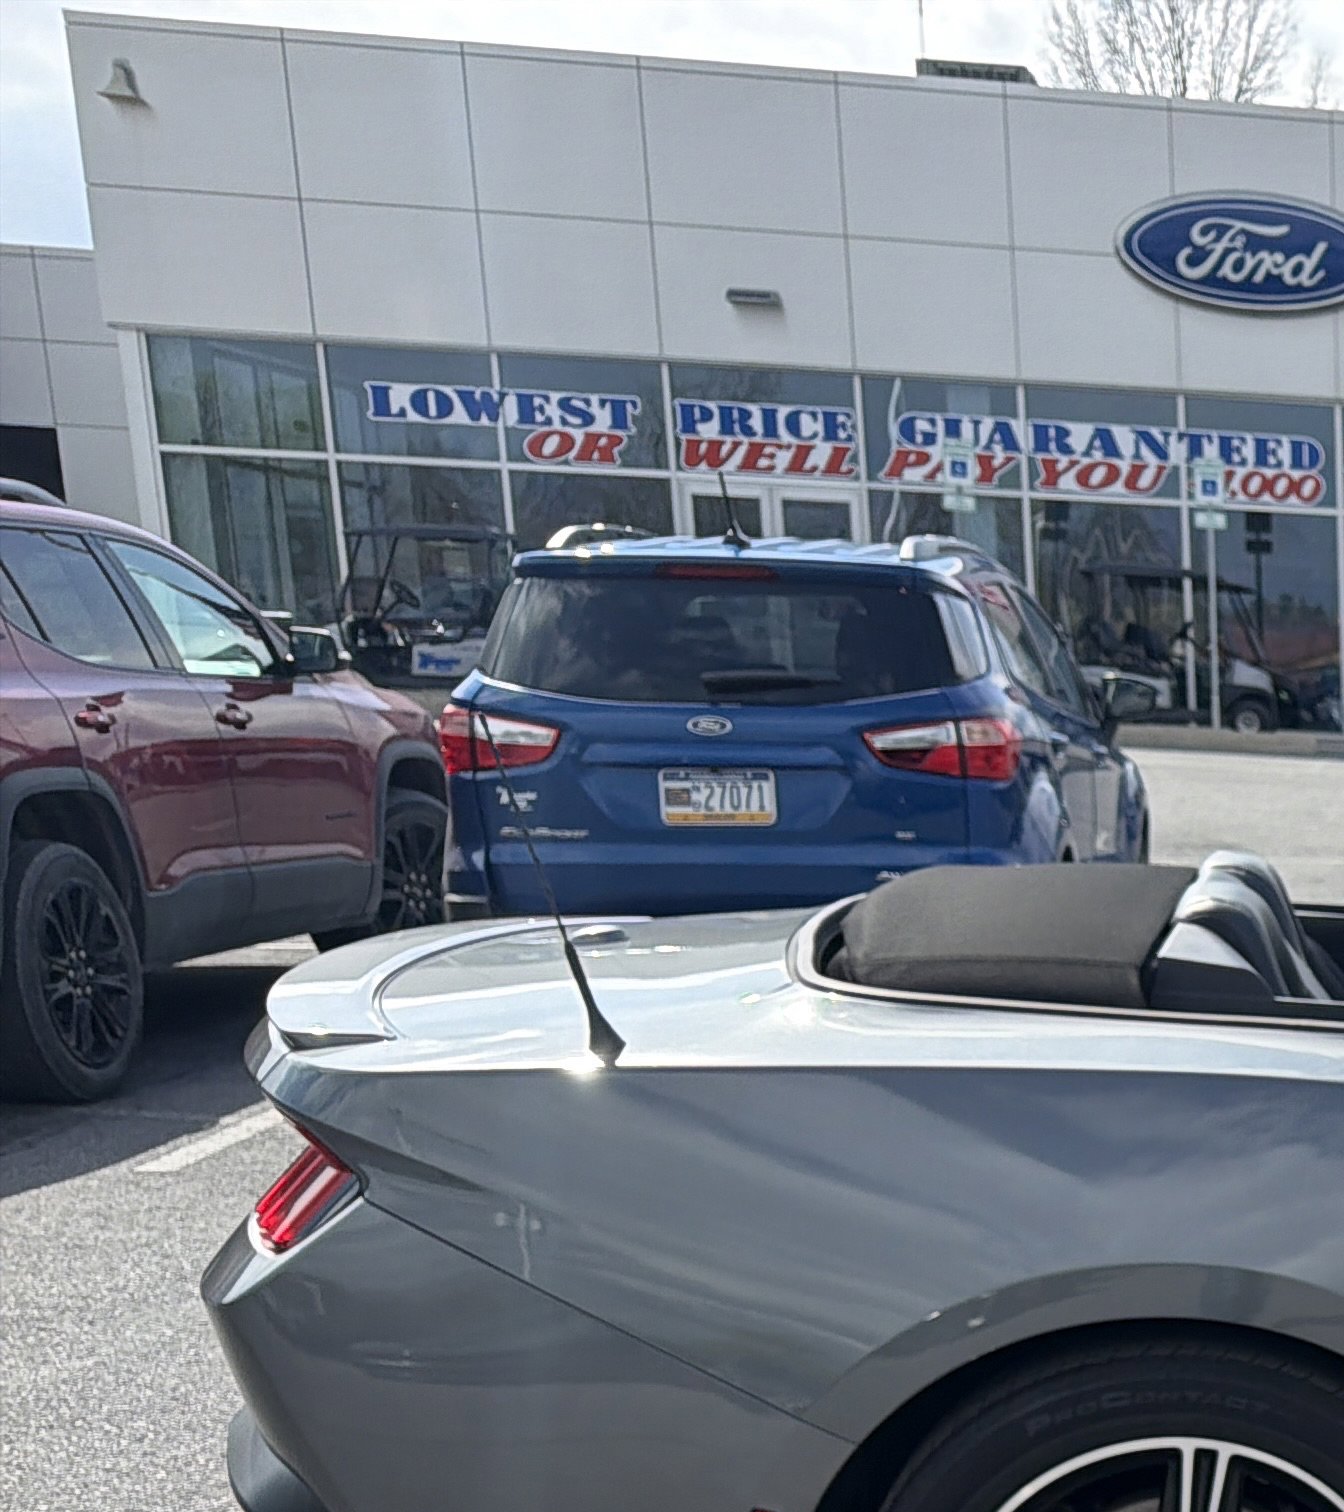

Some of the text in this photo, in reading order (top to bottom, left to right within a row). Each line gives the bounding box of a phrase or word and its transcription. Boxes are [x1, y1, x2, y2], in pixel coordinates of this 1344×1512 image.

[1175, 217, 1328, 287] Ford
[369, 384, 638, 431] LOWEST
[678, 402, 854, 443] PRICE
[899, 414, 1321, 470] GUARANTEED
[526, 430, 625, 463] OR
[1040, 458, 1167, 492] YOU
